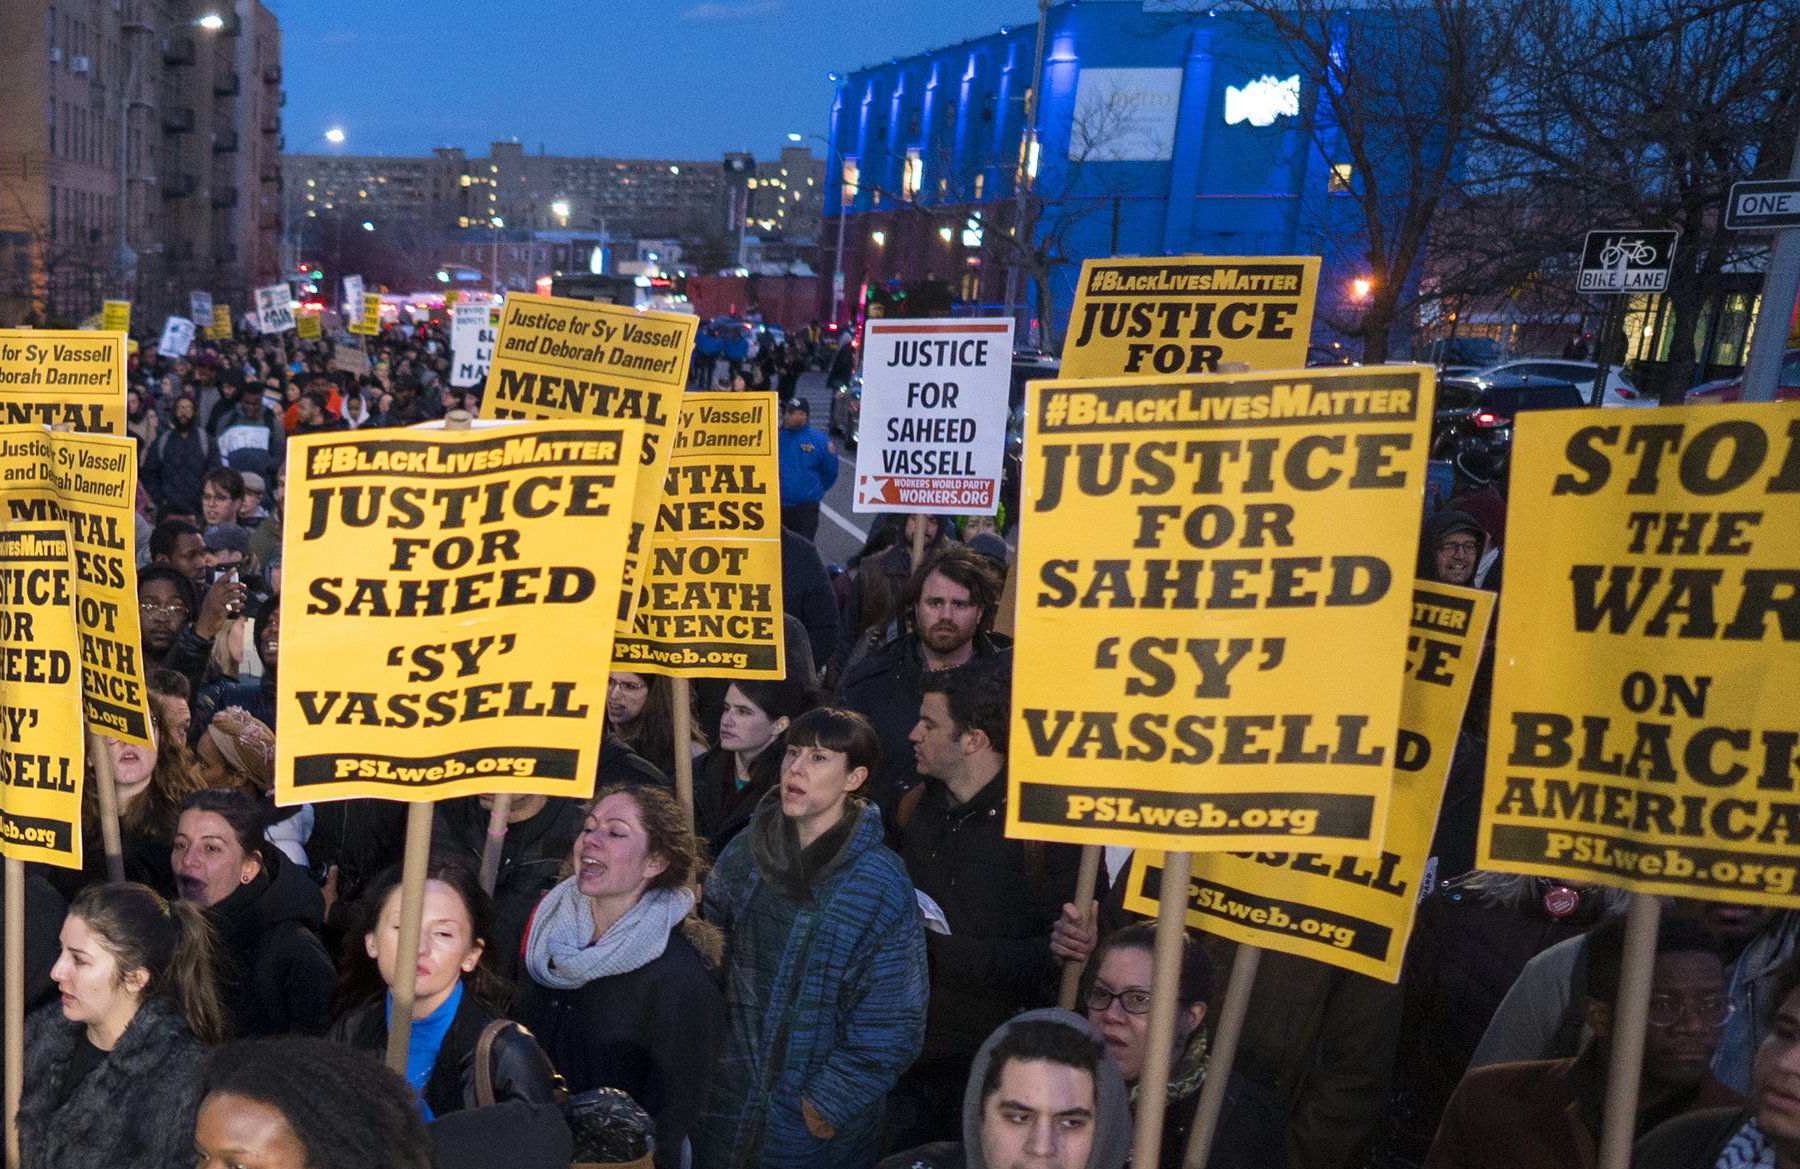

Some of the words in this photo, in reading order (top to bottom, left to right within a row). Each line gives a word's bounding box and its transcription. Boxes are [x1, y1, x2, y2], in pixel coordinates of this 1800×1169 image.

[1741, 194, 1792, 214] ONE
[1581, 273, 1617, 288] BIKE
[1623, 272, 1665, 288] LANE
[508, 308, 567, 334] Justice
[569, 315, 591, 336] for
[591, 318, 621, 343] Sy
[621, 322, 683, 350] Vassell
[1074, 301, 1299, 348] JUSTICE
[2, 344, 22, 362] for
[24, 344, 49, 365] Sy
[52, 344, 113, 363] Vassell
[505, 335, 538, 354] and
[538, 336, 606, 364] Deborah
[608, 346, 678, 375] Danner!
[886, 339, 989, 368] JUSTICE
[1123, 344, 1224, 374] FOR
[45, 367, 113, 387] Danner!
[495, 368, 668, 427] MENTAL
[906, 381, 960, 410] FOR
[699, 406, 764, 425] Vassell
[886, 417, 978, 444] SAHEED
[693, 429, 763, 449] Danner!
[57, 446, 76, 469] Sy
[78, 448, 127, 474] Vassell
[881, 449, 977, 476] VASSELL
[1033, 432, 1414, 513] JUSTICE
[3, 465, 37, 482] and
[73, 473, 126, 499] Danner!
[664, 464, 767, 496] NTAL
[893, 478, 931, 490] WORKERS
[931, 479, 962, 491] WORLD
[962, 480, 991, 491] PARTY
[302, 474, 617, 542] JUSTICE
[899, 489, 990, 506] WORKERS.ORG
[1132, 502, 1296, 550] FOR
[1626, 511, 1765, 557] THE
[389, 528, 521, 573] FOR
[652, 545, 749, 577] NOT
[306, 565, 597, 618] SAHEED
[1036, 555, 1393, 610] SAHEED
[1569, 564, 1800, 642] WAR
[614, 642, 749, 669] PSLweb.org
[294, 680, 590, 729] VASSELL
[1620, 670, 1713, 719] ON
[1021, 707, 1387, 768] VASSELL
[334, 756, 538, 784] PSLweb.org
[1065, 794, 1320, 834] PSLweb.org
[1543, 830, 1798, 895] PSLweb.org
